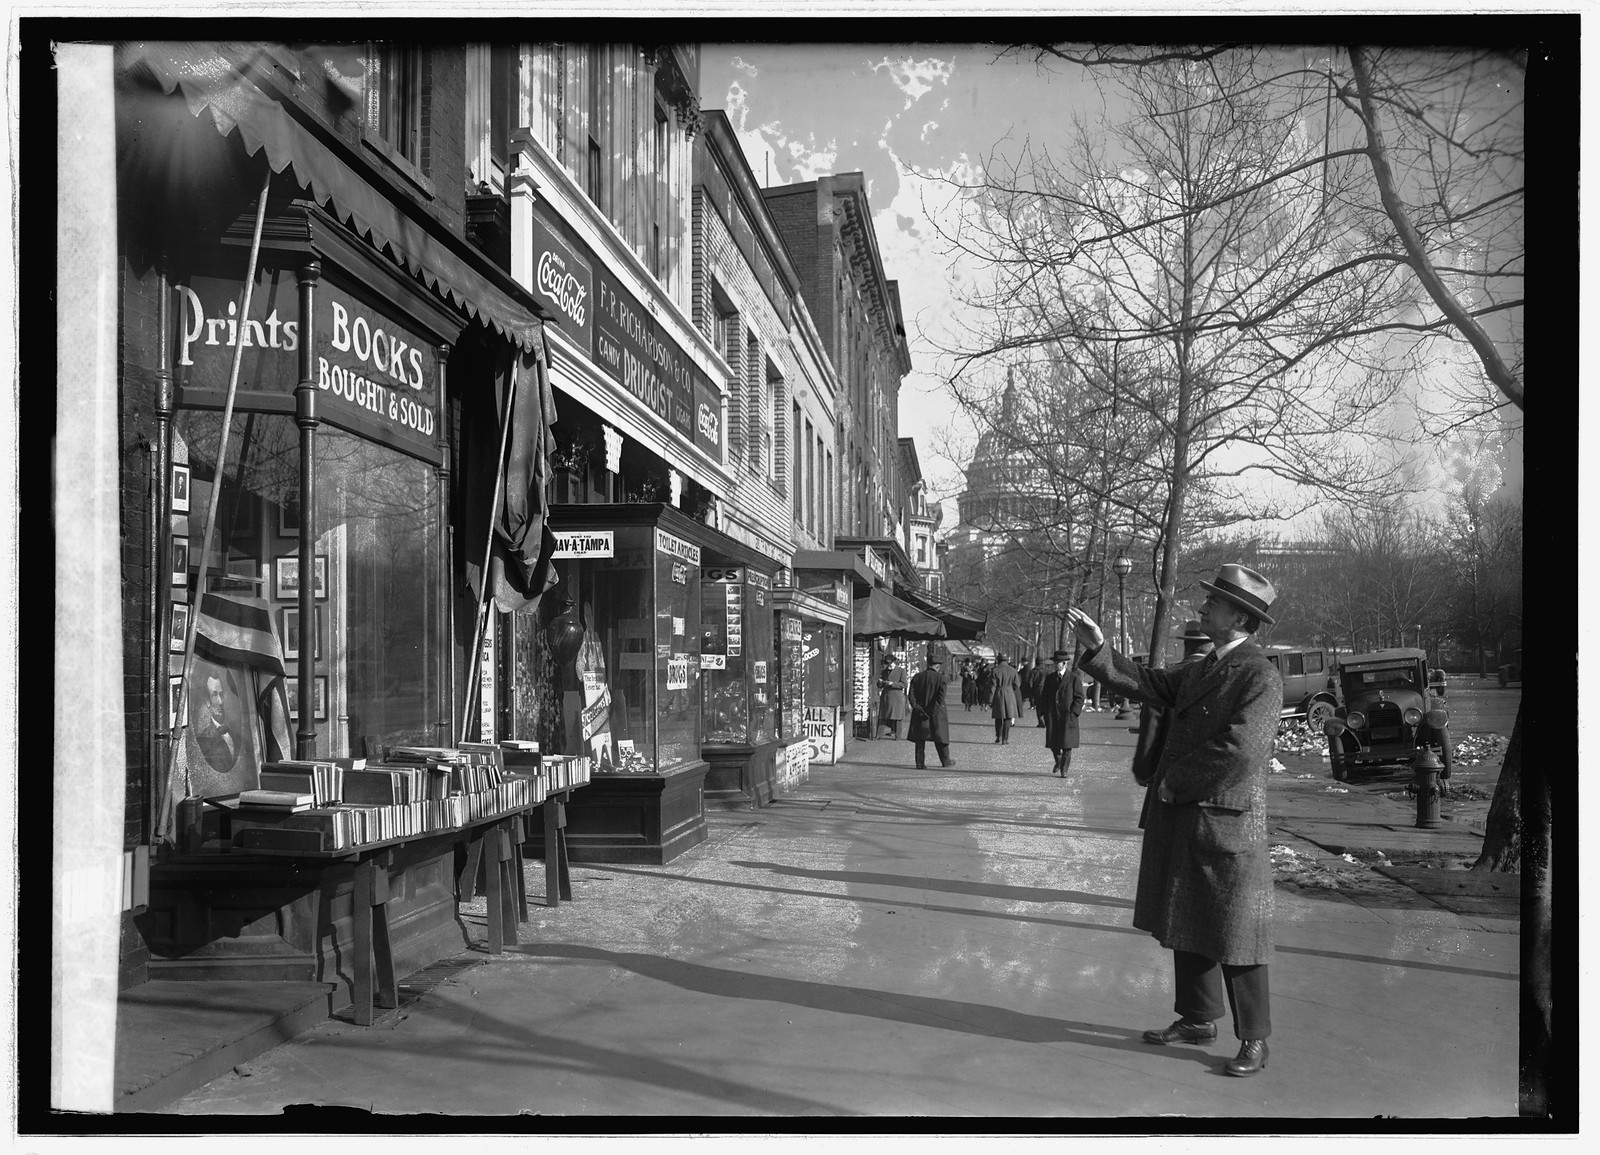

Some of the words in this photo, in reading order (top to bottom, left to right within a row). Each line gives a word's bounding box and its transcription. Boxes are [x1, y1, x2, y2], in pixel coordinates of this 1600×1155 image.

[174, 284, 298, 365] Prints
[331, 301, 423, 390] BOOKS
[619, 300, 674, 378] RICHARDSON
[674, 360, 680, 382] &
[318, 356, 387, 415] BOUGHT
[388, 393, 399, 421] &
[400, 400, 434, 436] SOLD
[598, 336, 621, 369] CANDY
[623, 347, 673, 423] DRUGGIST
[658, 533, 678, 554] TOILET
[678, 541, 699, 562] ARTICLES
[802, 723, 833, 737] HINES
[804, 707, 826, 722] ALL
